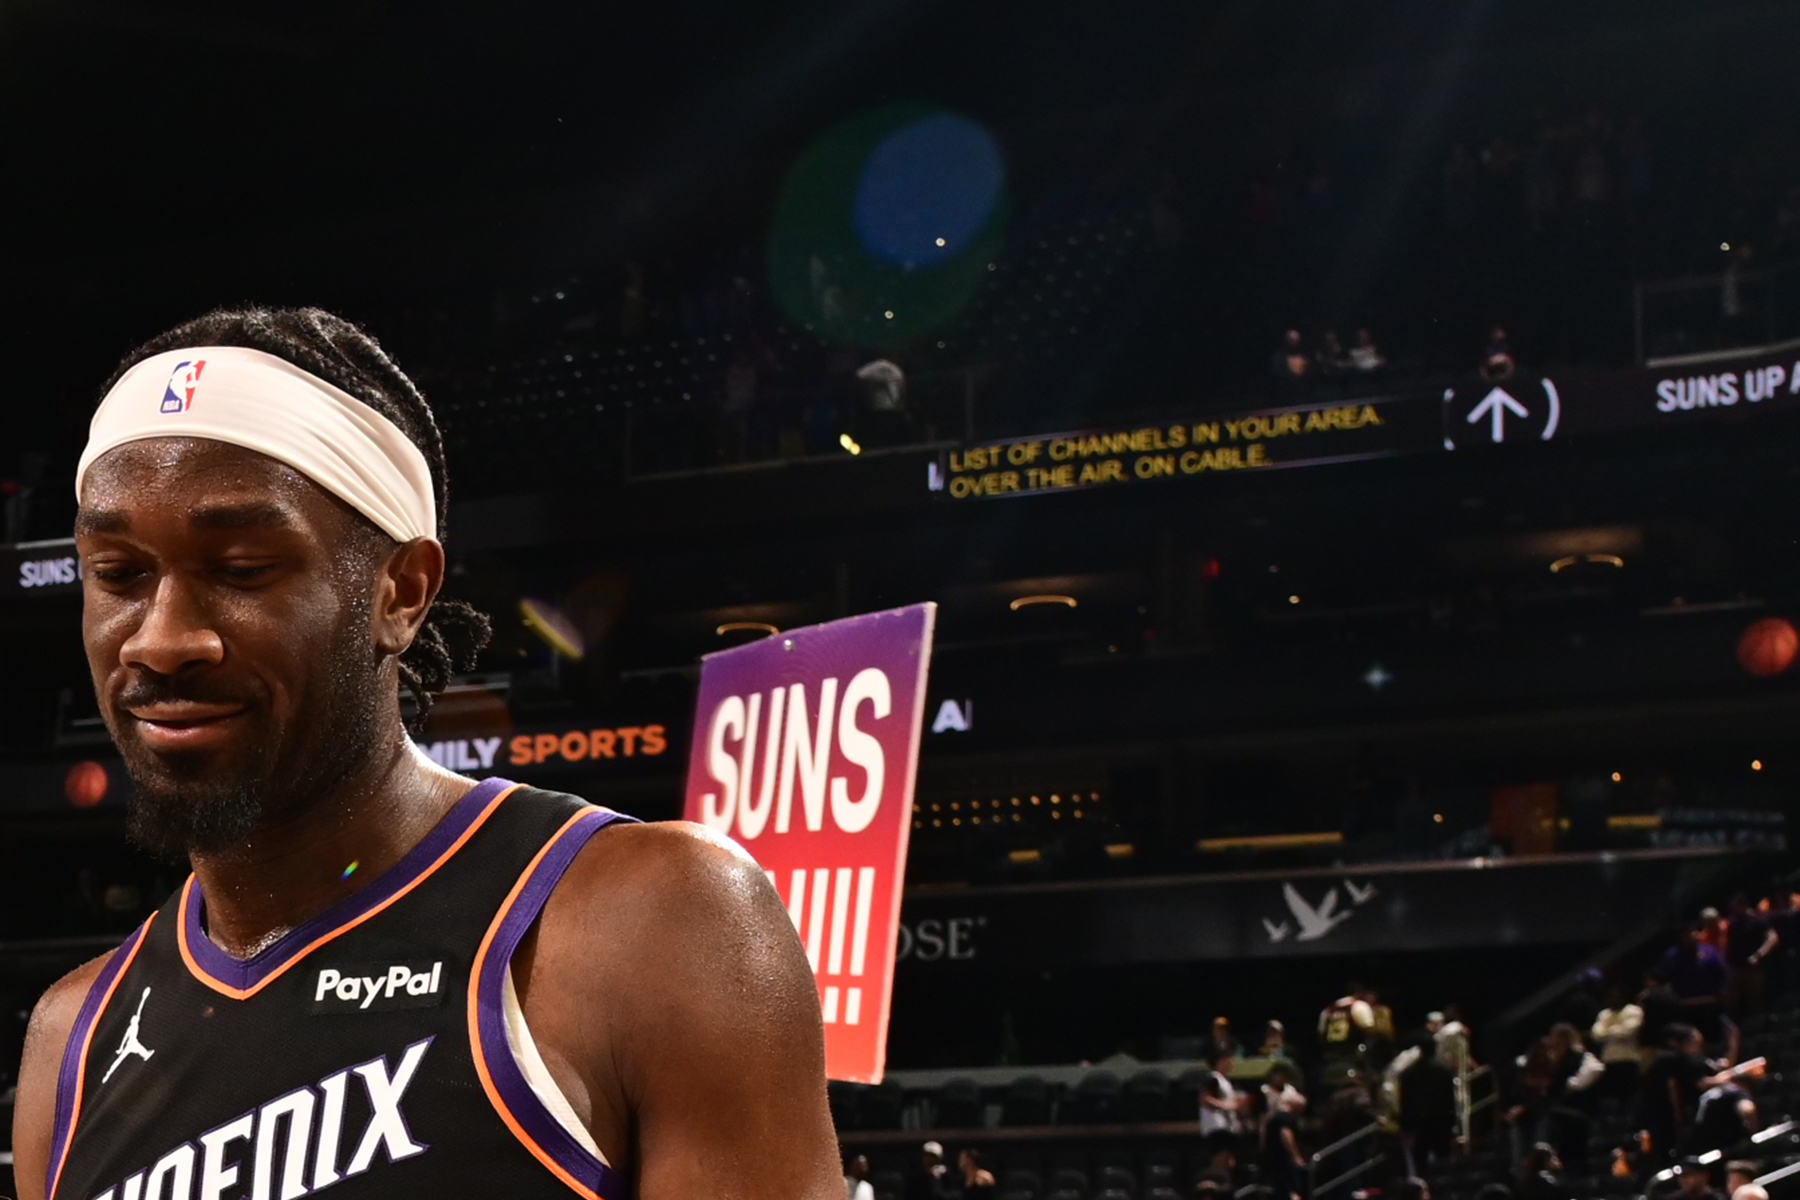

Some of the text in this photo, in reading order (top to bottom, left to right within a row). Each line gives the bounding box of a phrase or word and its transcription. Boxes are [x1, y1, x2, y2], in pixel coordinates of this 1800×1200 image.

[1656, 373, 1739, 413] SUNS
[1744, 365, 1785, 402] UP
[949, 445, 1001, 473] LIST
[1007, 442, 1042, 466] OF
[1048, 425, 1187, 461] CHANNELS
[1193, 419, 1220, 444] IN
[1224, 411, 1301, 440] YOUR
[949, 471, 1020, 499] OVER
[1026, 463, 1076, 490] THE
[1134, 453, 1176, 479] ON
[18, 556, 76, 588] SUNS
[509, 723, 668, 766] SPORTS
[702, 667, 892, 840] SUNS
[314, 961, 443, 1009] PayPal
